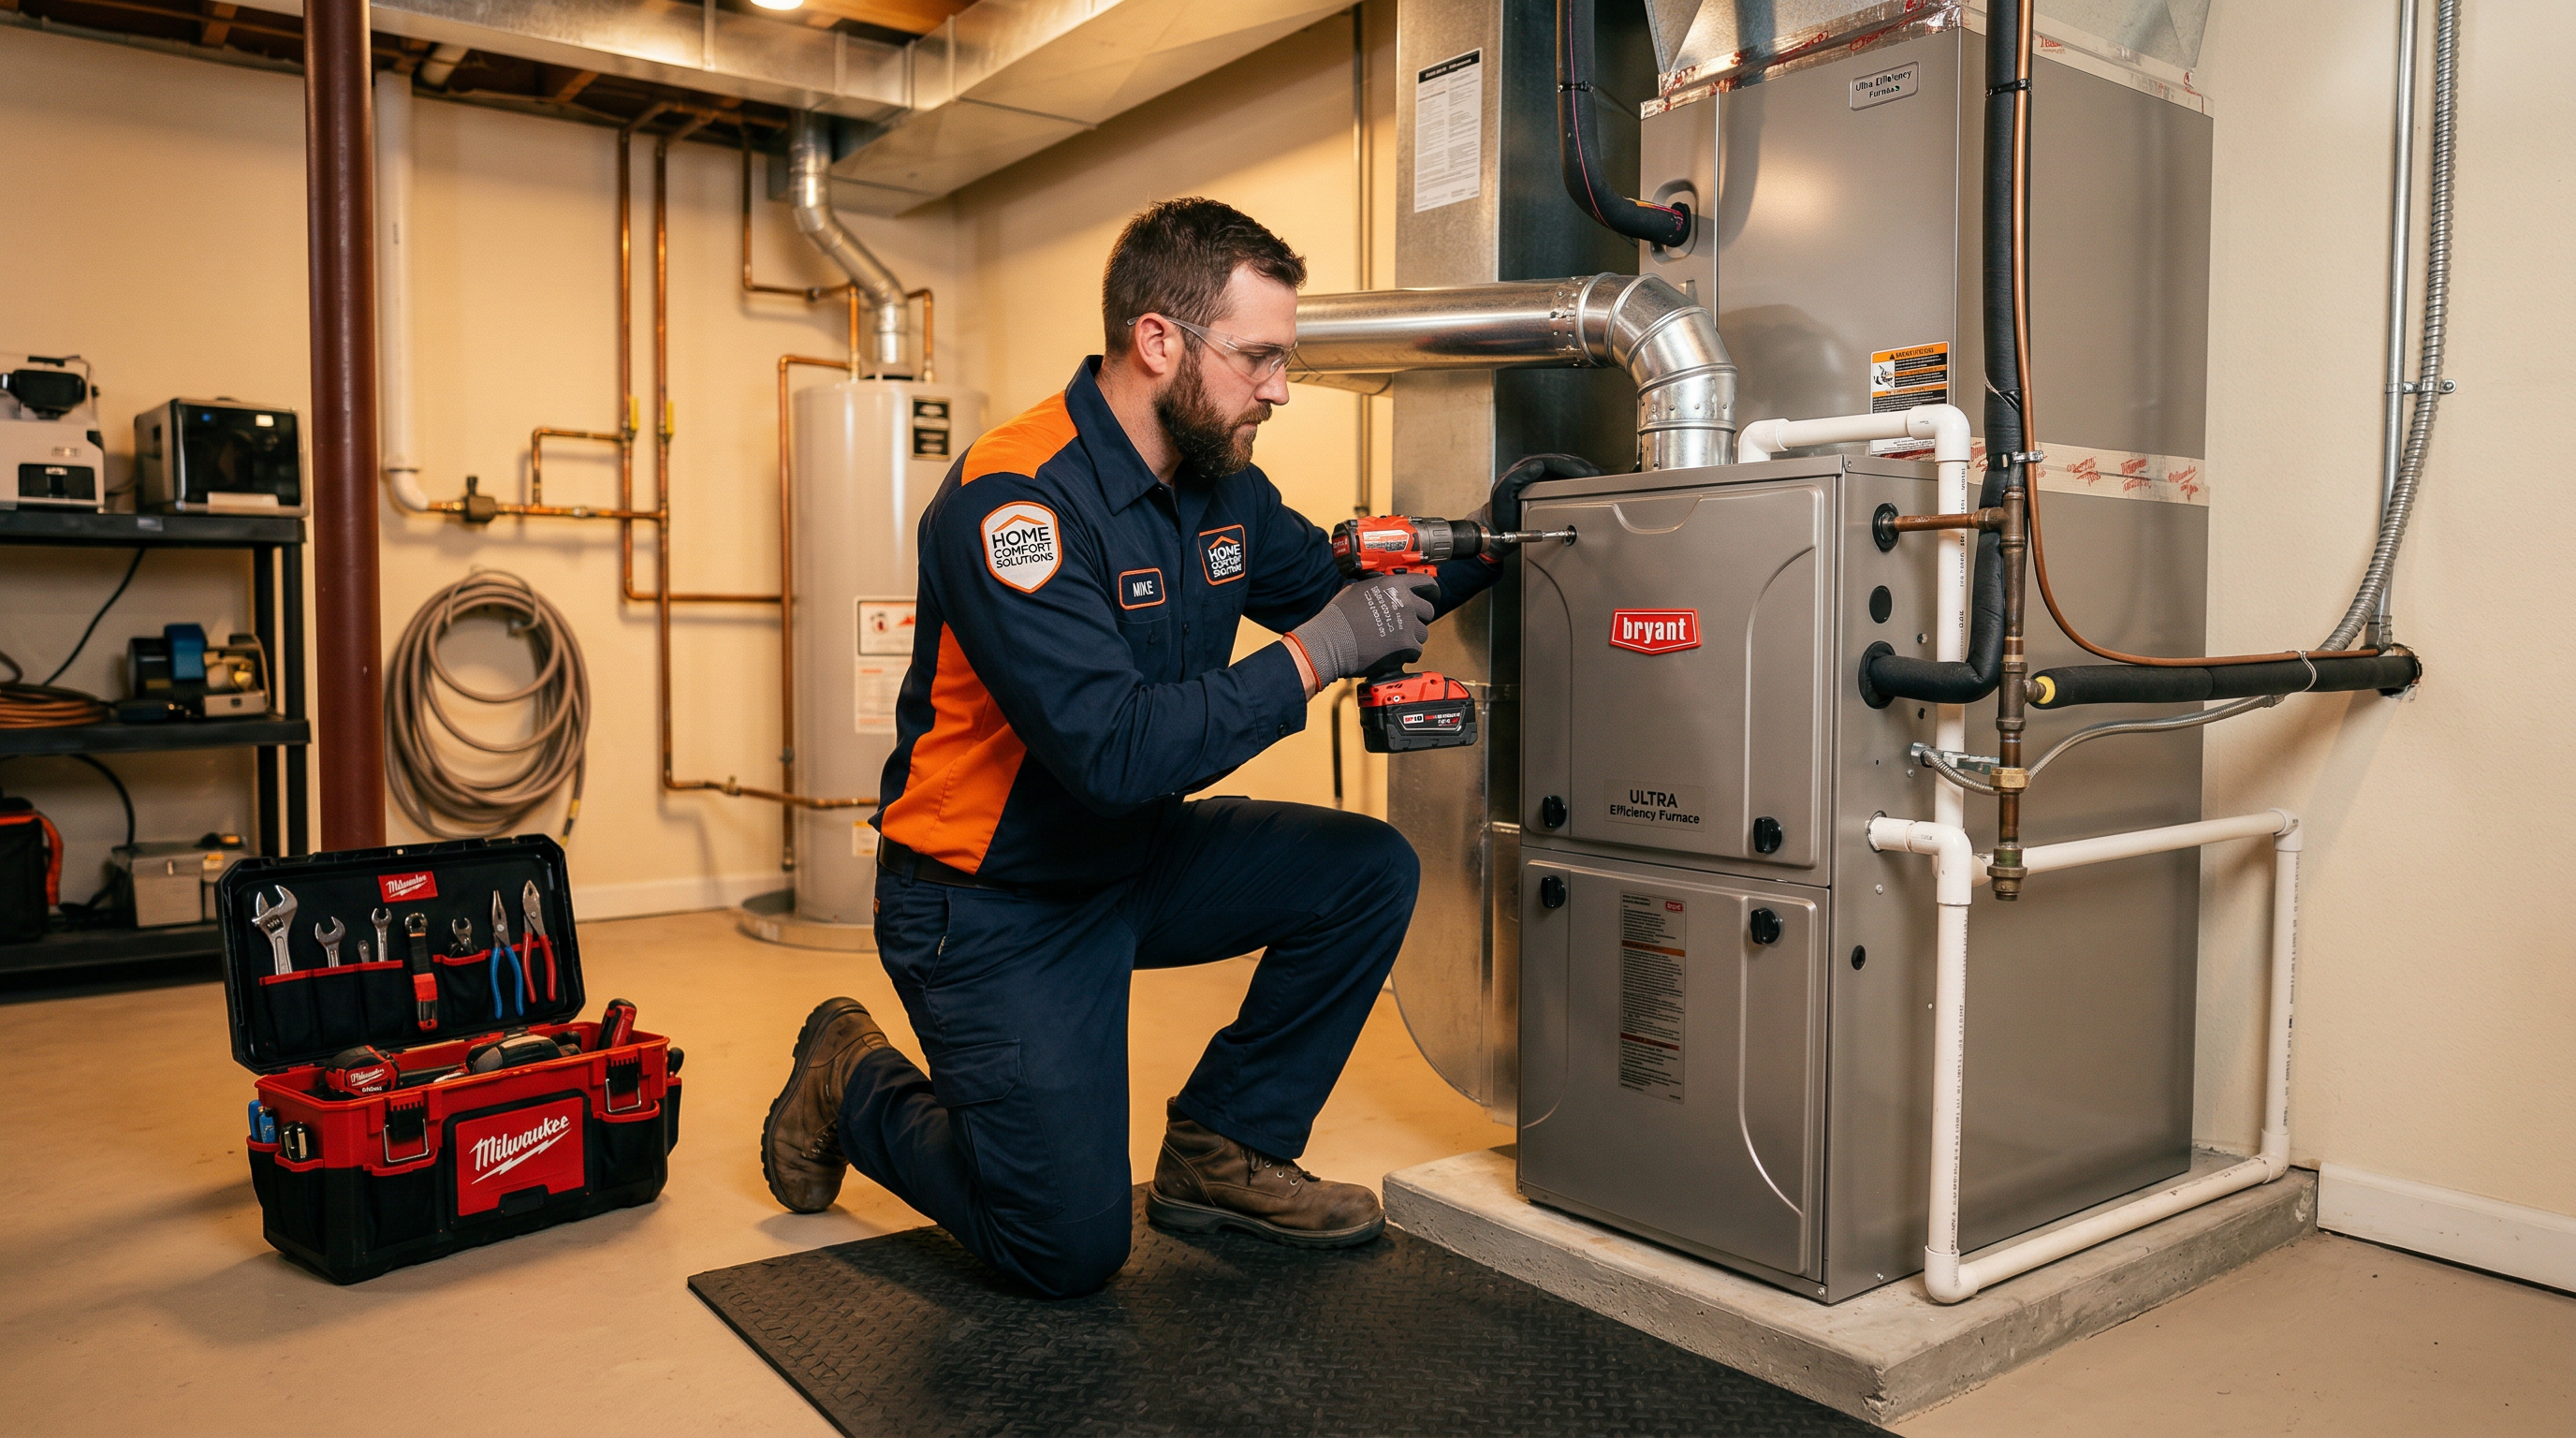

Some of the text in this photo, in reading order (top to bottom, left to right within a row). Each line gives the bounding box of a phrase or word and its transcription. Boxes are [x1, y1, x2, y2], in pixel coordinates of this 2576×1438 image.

[992, 526, 1050, 549] HOME
[994, 542, 1051, 559] COMFORT
[996, 552, 1054, 568] SOLUTIONS
[1133, 580, 1154, 597] MIKE
[1623, 617, 1686, 644] bryant
[1630, 789, 1678, 808] ULTRA
[1659, 810, 1700, 824] Furnace
[469, 1115, 570, 1171] Milwaukee
